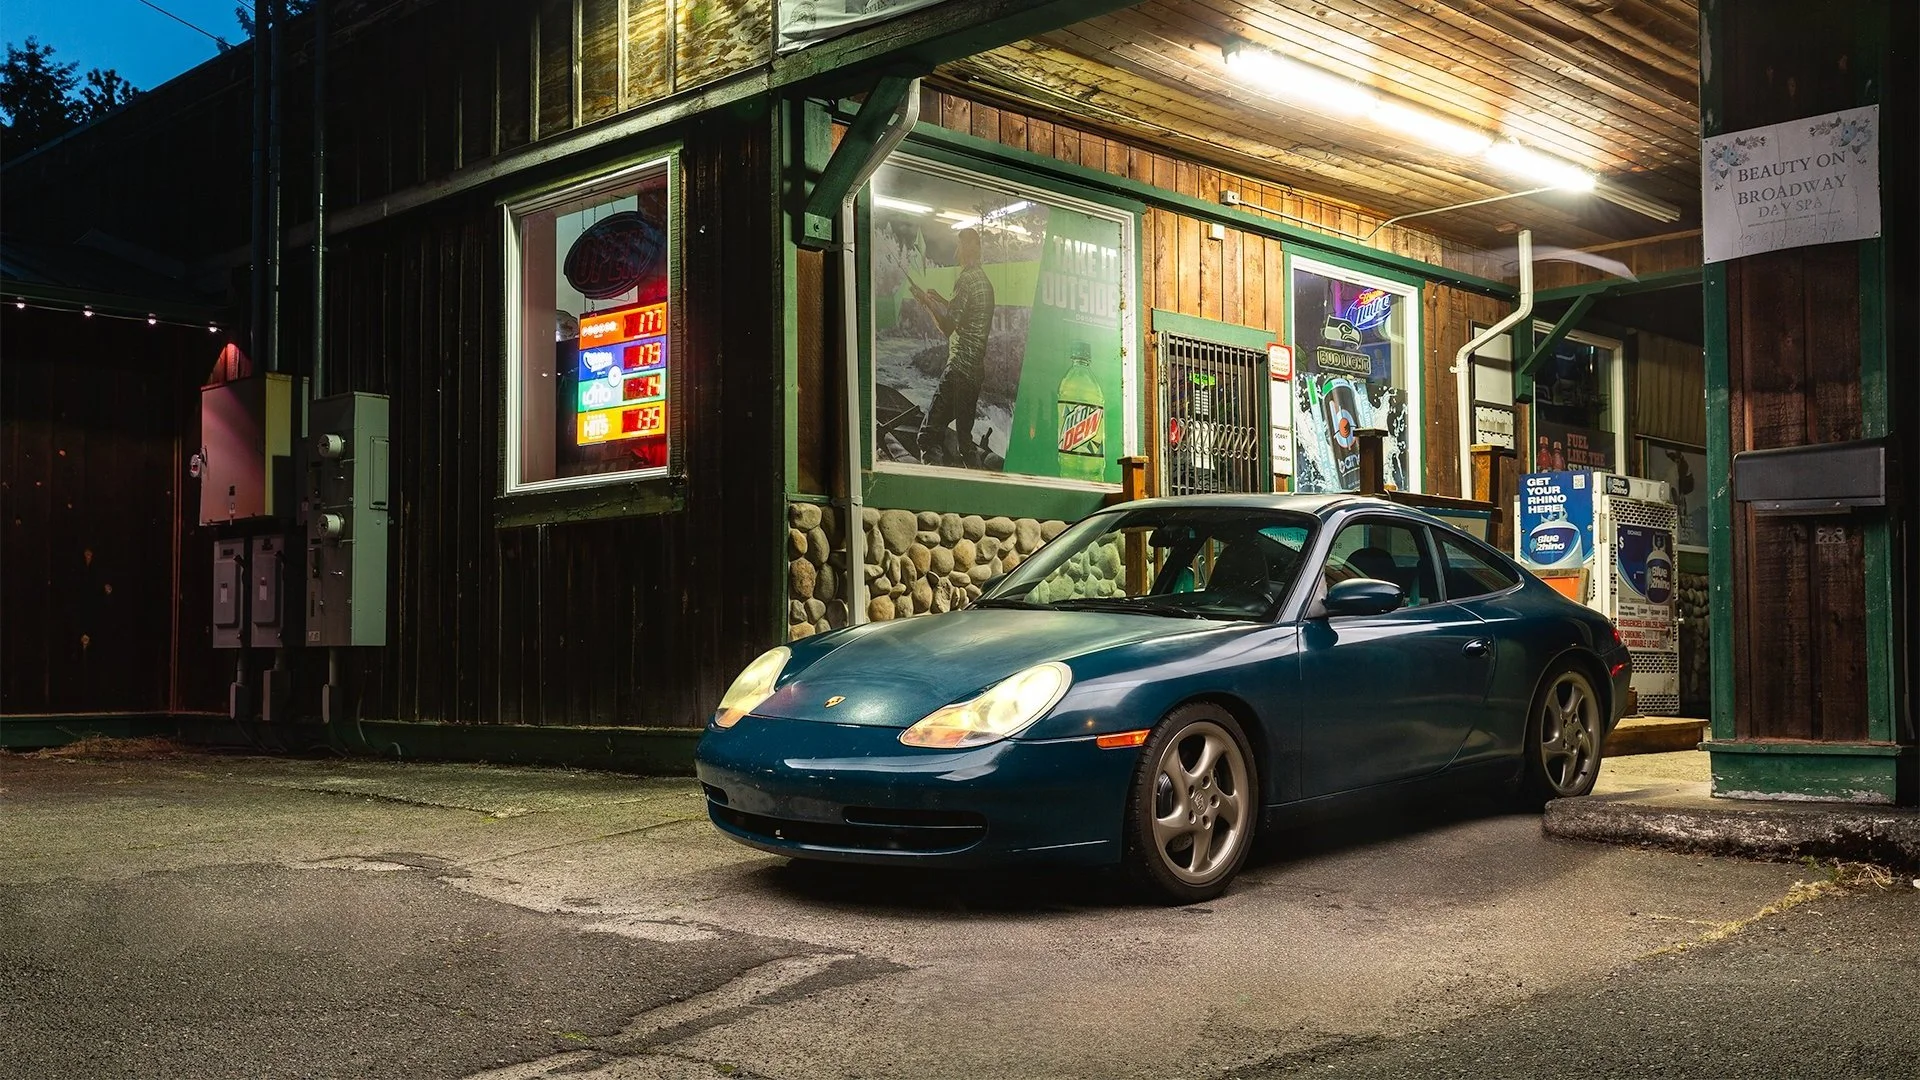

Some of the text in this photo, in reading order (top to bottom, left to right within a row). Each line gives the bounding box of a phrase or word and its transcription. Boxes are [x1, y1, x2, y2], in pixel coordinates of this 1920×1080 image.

[1738, 151, 1846, 182] BEAUTY ON
[1737, 174, 1847, 205] BROADWAY
[1758, 197, 1823, 218] DAY SPA
[1053, 235, 1117, 283] TAKE IT
[1043, 272, 1117, 318] OUTSIDE
[639, 309, 662, 333] 177
[1319, 350, 1369, 370] BUD LIGHT
[638, 407, 660, 430] 135
[1567, 433, 1588, 449] FUEL
[1338, 454, 1360, 474] ban
[1567, 448, 1605, 466] LIKE THE
[1526, 477, 1551, 487] GET
[1526, 486, 1560, 496] YOUR
[1527, 494, 1567, 505] RHINO
[1528, 504, 1564, 514] HERE!
[1536, 542, 1565, 551] Rhino
[1537, 534, 1560, 544] Blue
